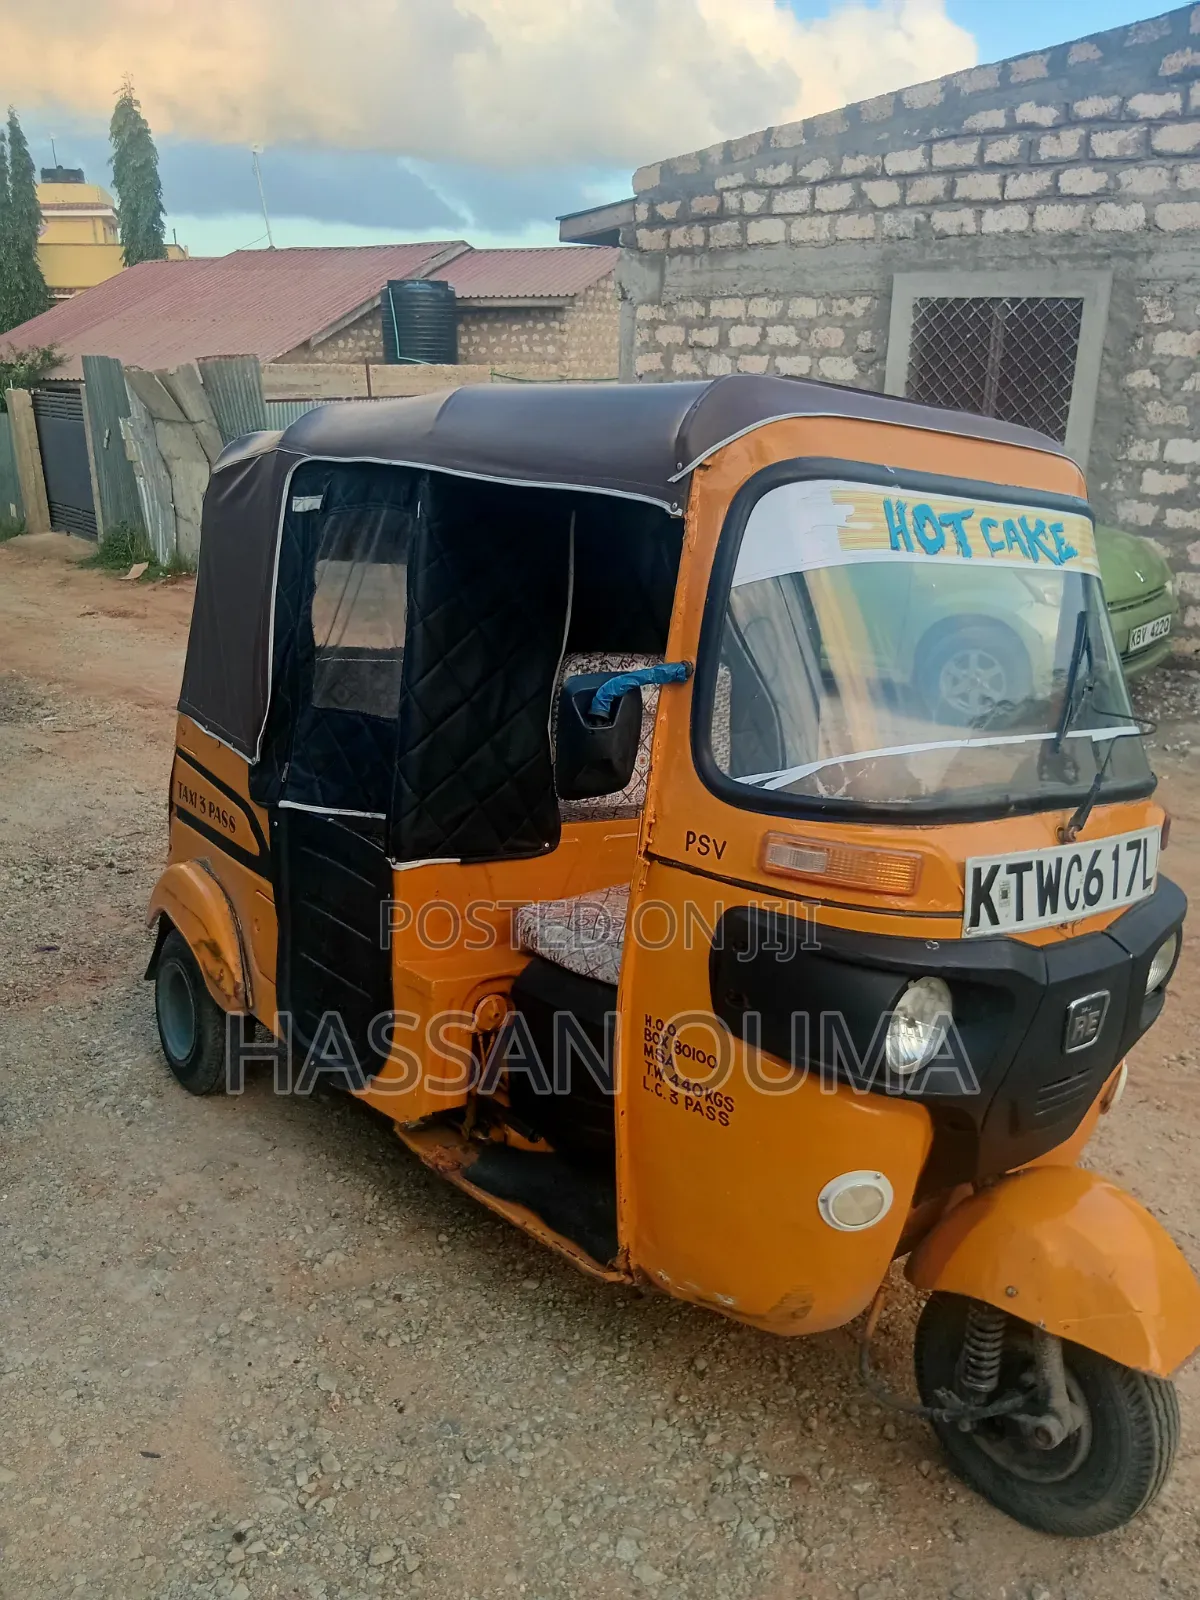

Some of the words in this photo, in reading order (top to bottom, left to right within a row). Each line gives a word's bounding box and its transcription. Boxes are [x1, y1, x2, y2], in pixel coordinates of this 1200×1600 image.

[883, 498, 974, 558] HOT
[980, 515, 1078, 566] CAKE
[1131, 627, 1147, 648] KBV
[178, 781, 197, 808] TAXI
[200, 795, 206, 814] 3
[209, 802, 236, 833] PASS
[686, 830, 727, 860] PSV
[969, 838, 1153, 928] KTWC617L
[1071, 1010, 1100, 1041] RE
[644, 1028, 668, 1049] BOX
[674, 1040, 717, 1069] 80100
[644, 1043, 675, 1070] MSA
[643, 1075, 666, 1100] L.C.
[670, 1089, 678, 1105] 3
[685, 1095, 730, 1126] PASS
